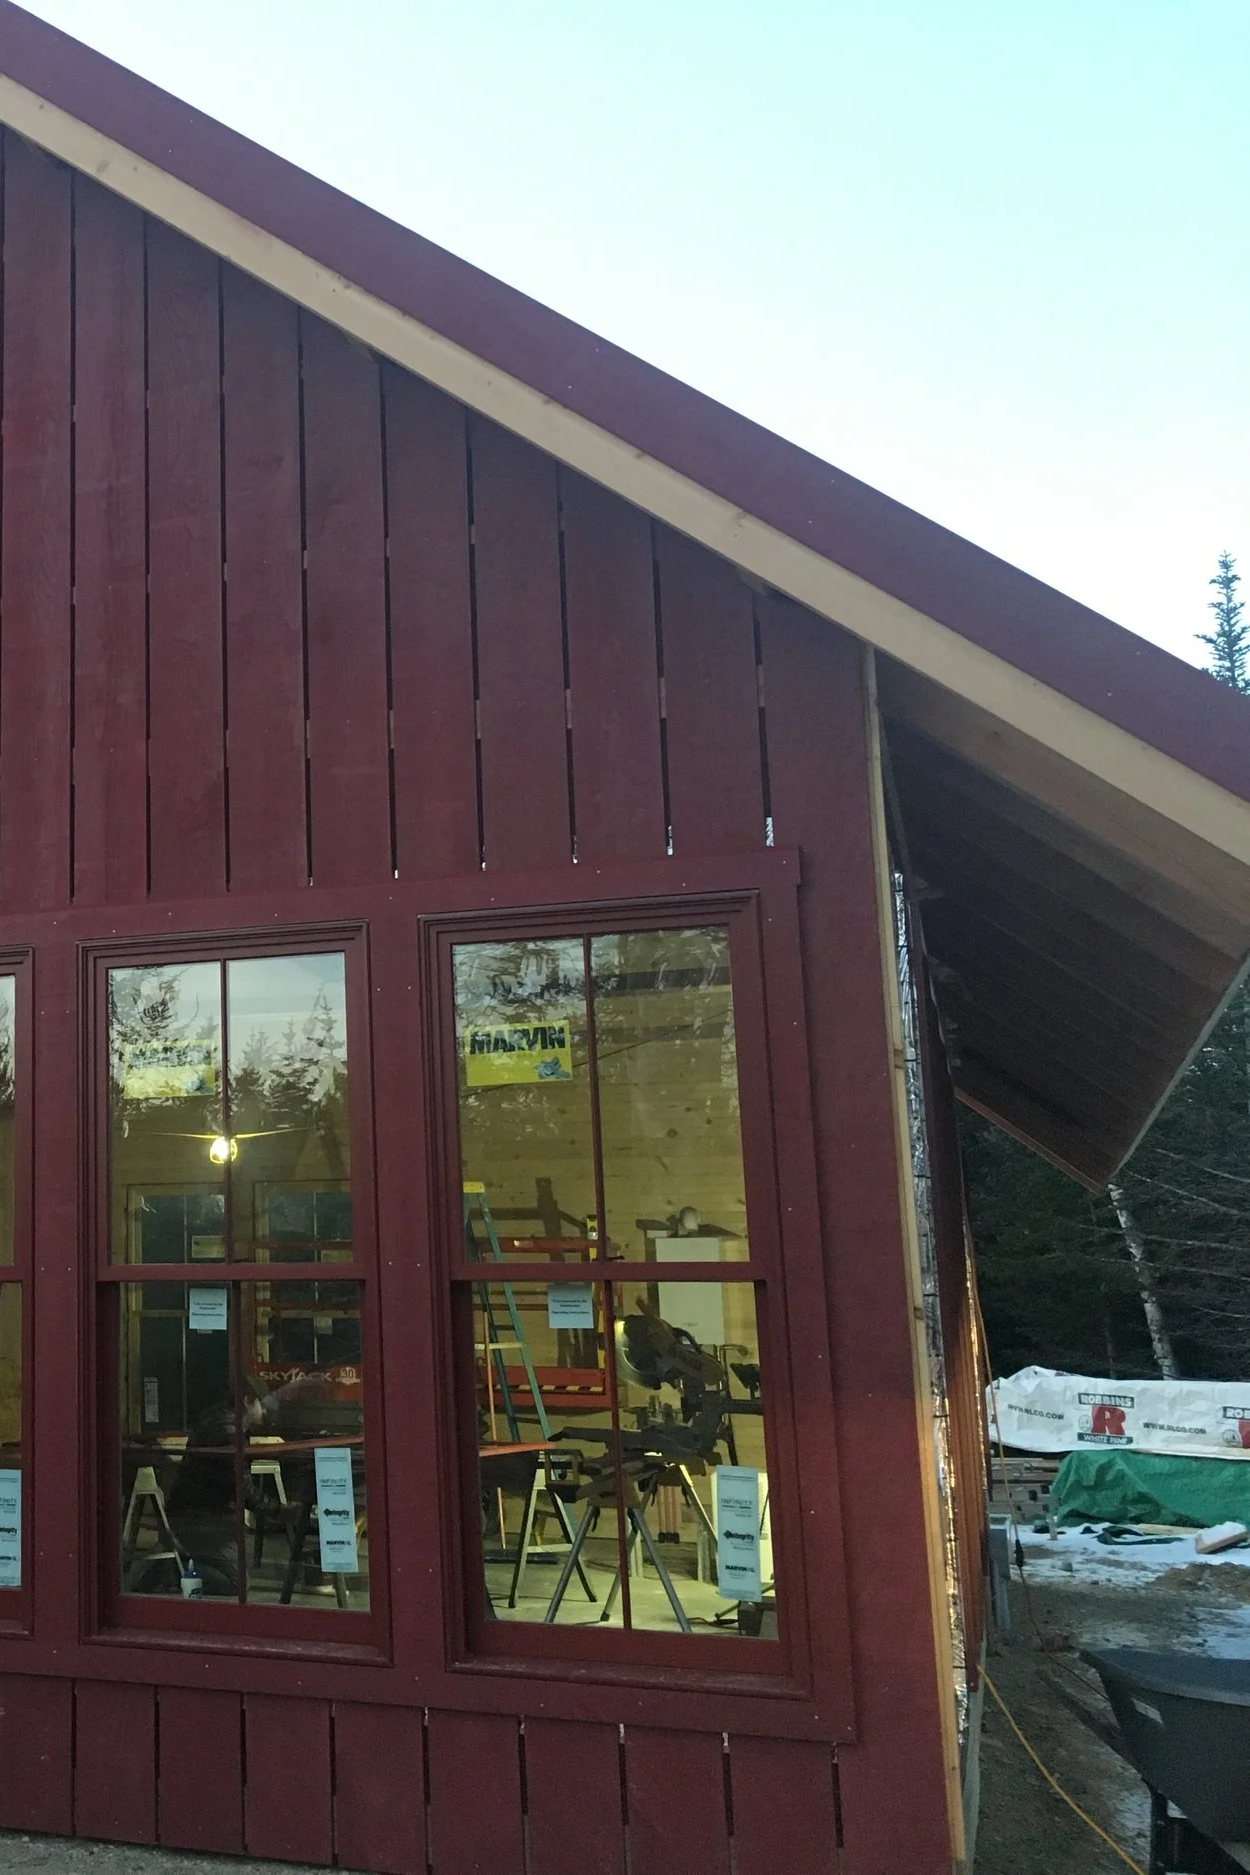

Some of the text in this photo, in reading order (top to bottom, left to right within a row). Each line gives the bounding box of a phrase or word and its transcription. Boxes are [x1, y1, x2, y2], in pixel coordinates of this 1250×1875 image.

[469, 1026, 566, 1054] MARVIN
[258, 1367, 334, 1383] SKYJACK
[1080, 1395, 1132, 1407] ROBBINS
[1225, 1408, 1250, 1420] ROB
